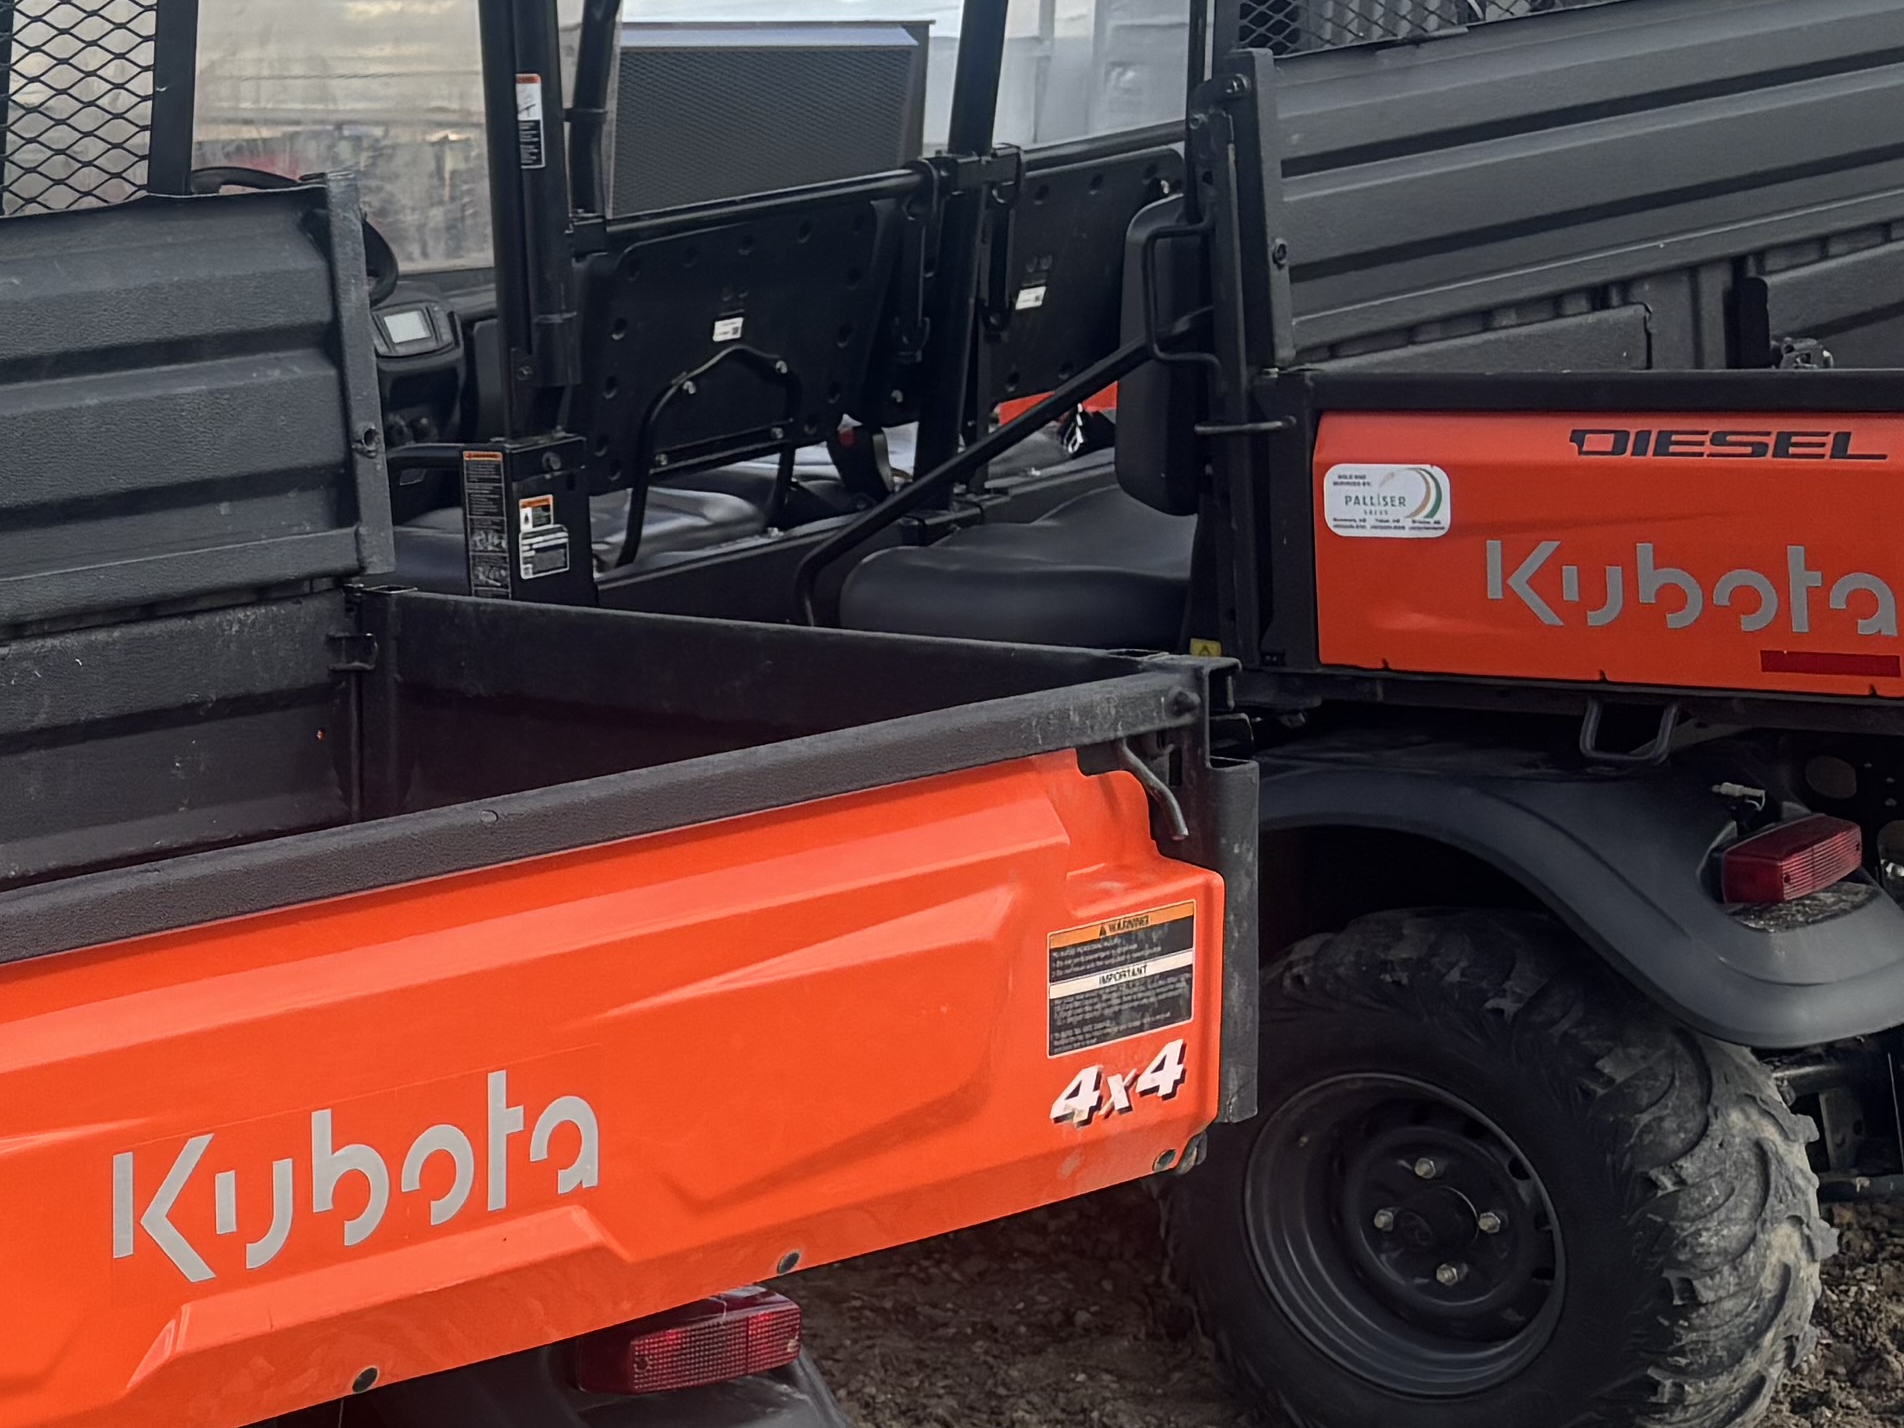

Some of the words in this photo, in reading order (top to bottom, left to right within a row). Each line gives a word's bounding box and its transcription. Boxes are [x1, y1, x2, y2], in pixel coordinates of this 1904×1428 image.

[1569, 429, 1889, 460] DIESEL
[1344, 493, 1406, 507] PALLISER
[1486, 540, 1898, 637] Kubota
[1099, 965, 1147, 985] IMPORTANT
[1049, 1038, 1187, 1129] 4x4
[112, 1069, 599, 1283] Kubota
